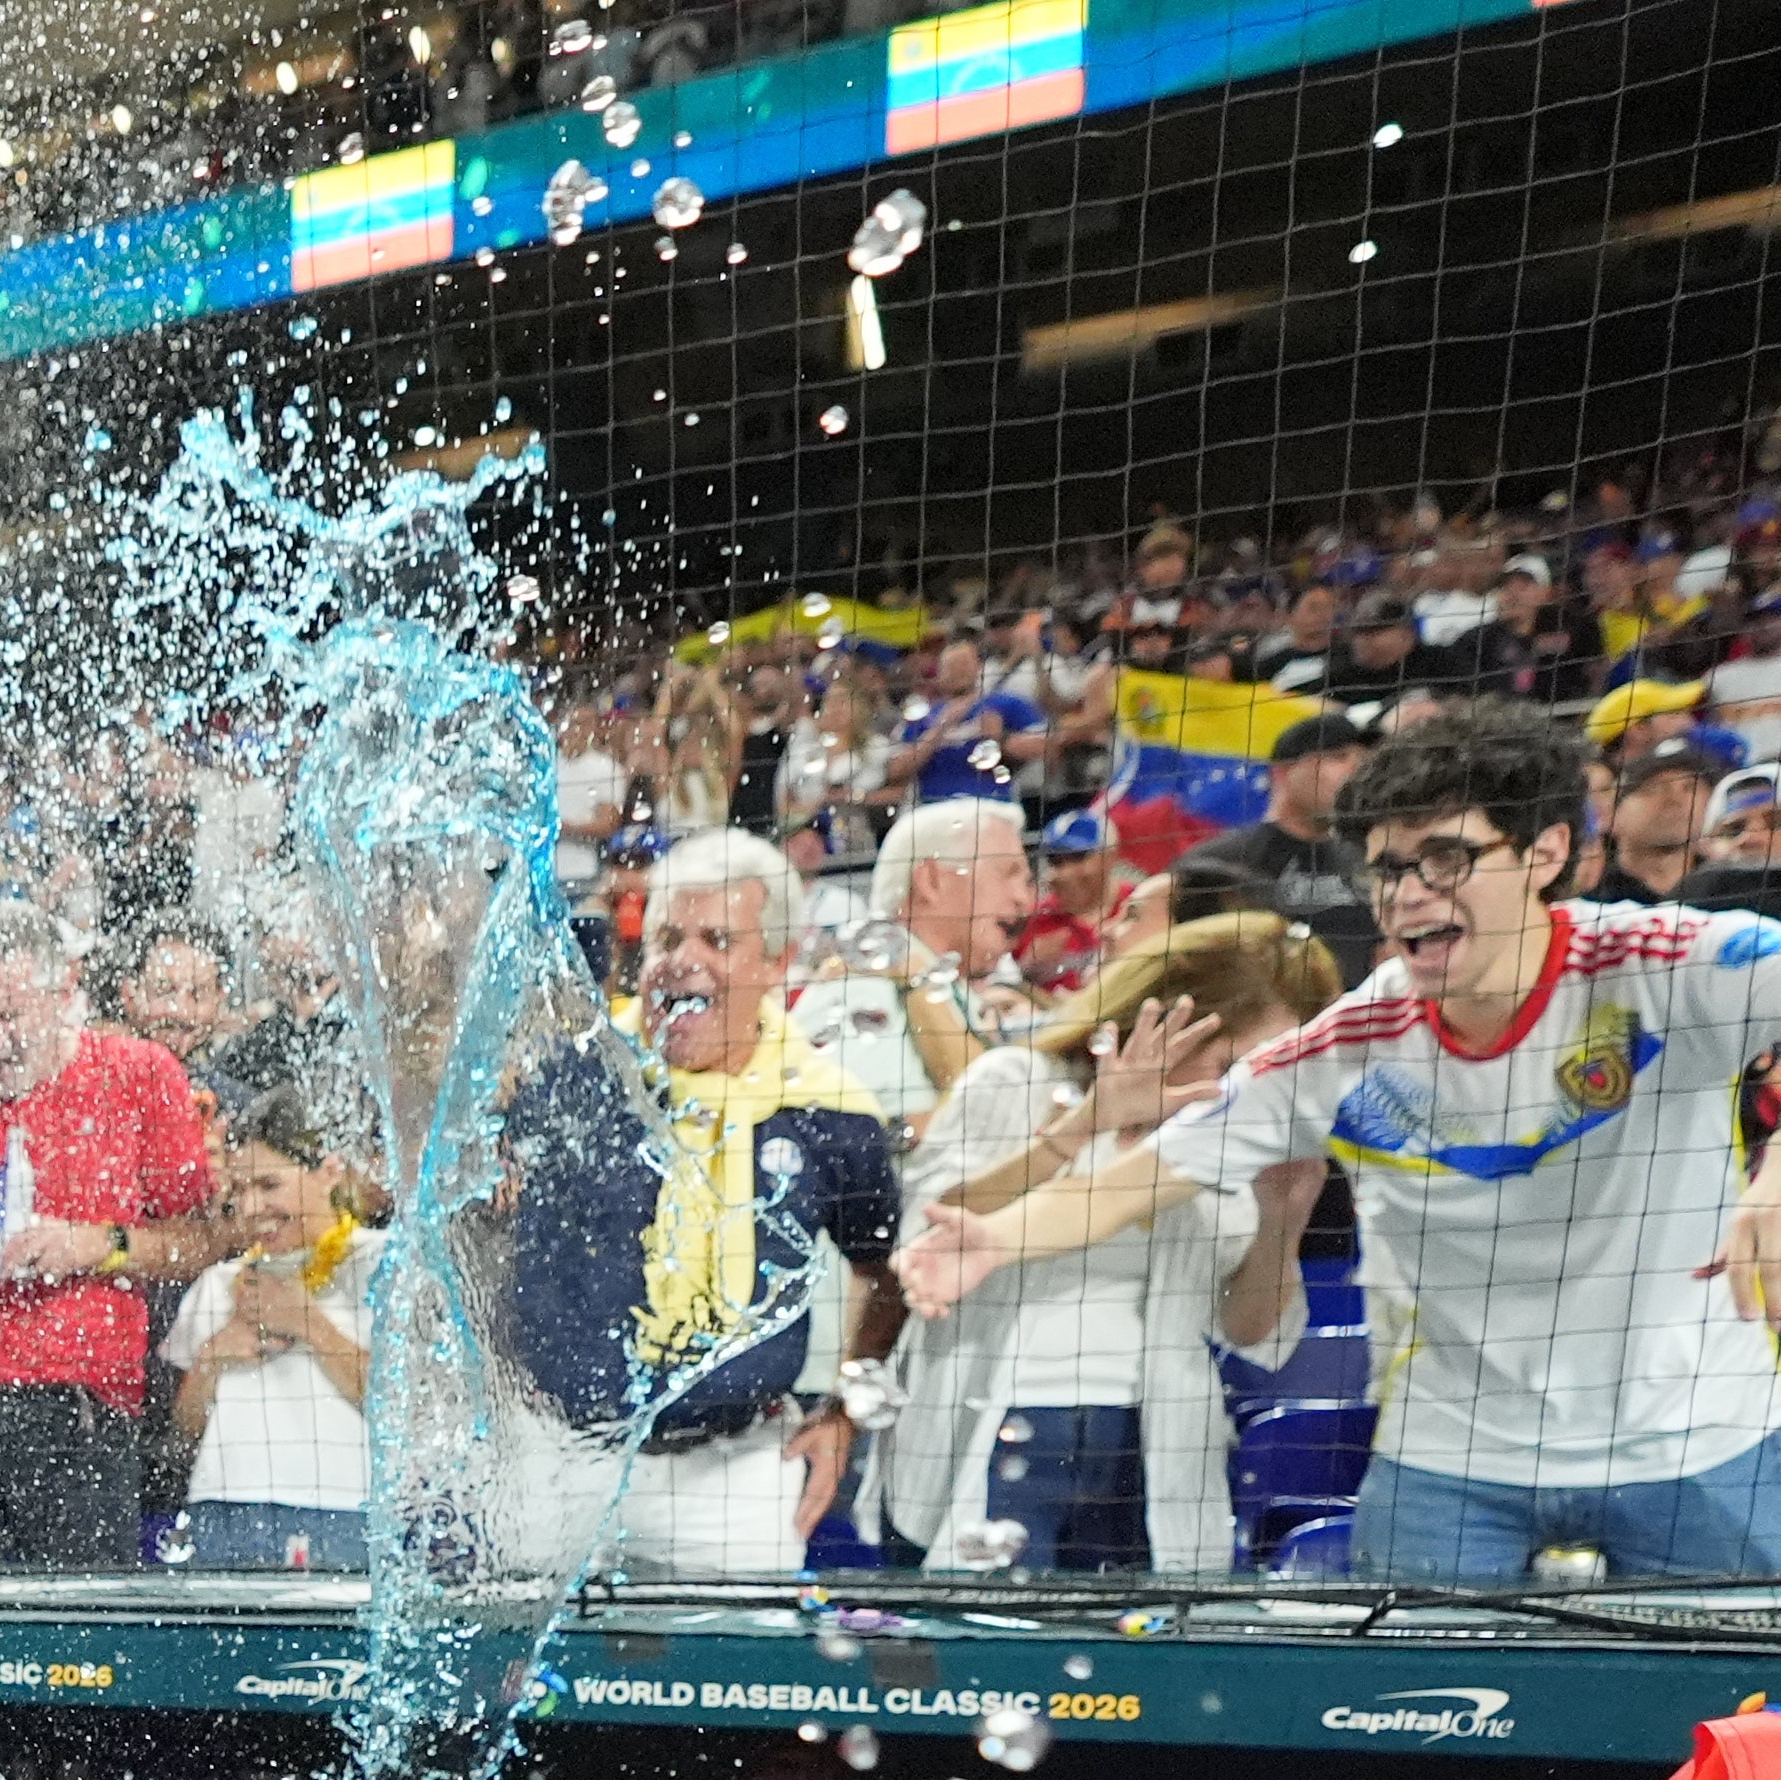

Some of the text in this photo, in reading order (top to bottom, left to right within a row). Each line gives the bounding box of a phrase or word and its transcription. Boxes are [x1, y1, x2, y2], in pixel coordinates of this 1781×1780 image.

[46, 1664, 113, 1688] 2026
[575, 1678, 1142, 1722] WORLD BASEBALL CLASSIC 2026
